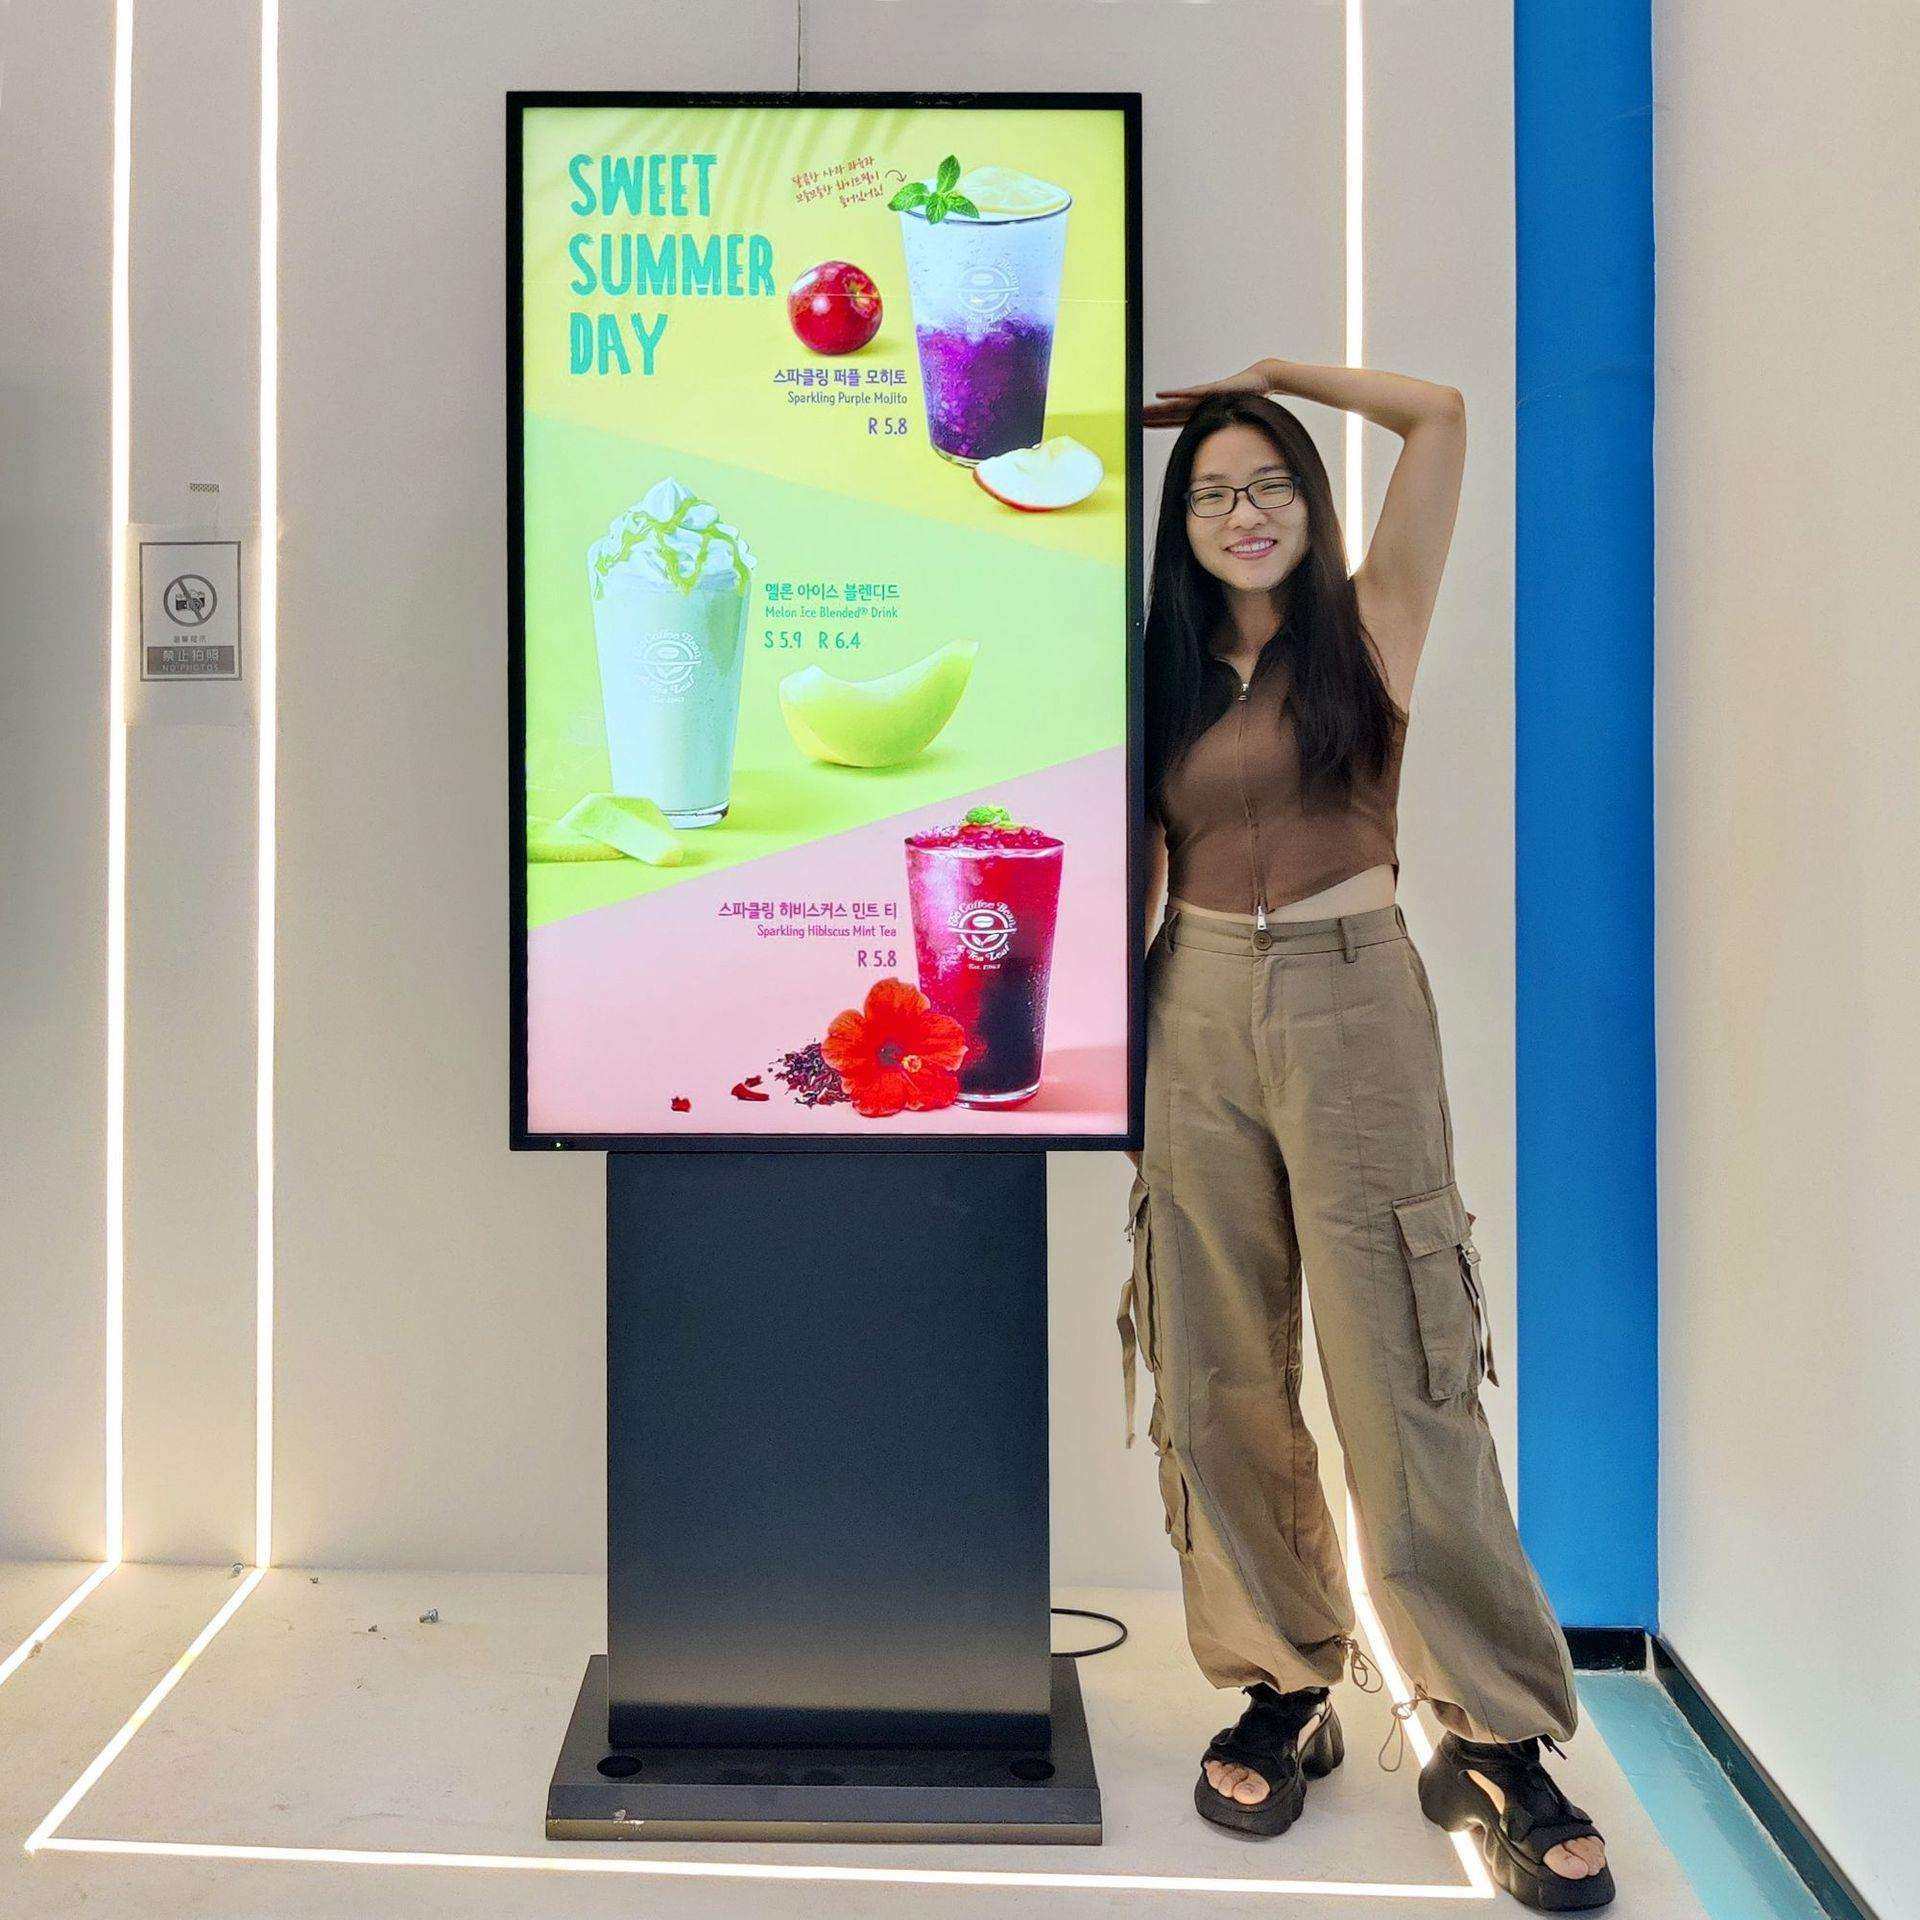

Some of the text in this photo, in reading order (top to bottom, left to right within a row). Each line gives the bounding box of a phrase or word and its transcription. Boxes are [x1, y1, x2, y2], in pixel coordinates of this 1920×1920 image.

[568, 154, 718, 217] SWEET
[568, 233, 776, 296] SUMMER
[570, 312, 669, 376] DAY
[773, 368, 908, 387] 스파클링 퍼플 모히토
[787, 391, 908, 405] Sparkling Purple Mojito
[868, 417, 908, 435] R 5.8
[765, 583, 900, 601] 멜론 아이스 블렌디드
[765, 606, 797, 618] Melon
[801, 606, 817, 618] Ice
[871, 606, 898, 618] Drink
[764, 630, 861, 649] S 5.9 R 6.4
[162, 648, 220, 662] 禁止拍照
[718, 902, 897, 920] 스파클링 히비스커스 민트 티
[959, 899, 996, 914] Coffee
[757, 924, 897, 939] Sparkling Hibiscus Mint Tea
[857, 950, 898, 968] R 5.8
